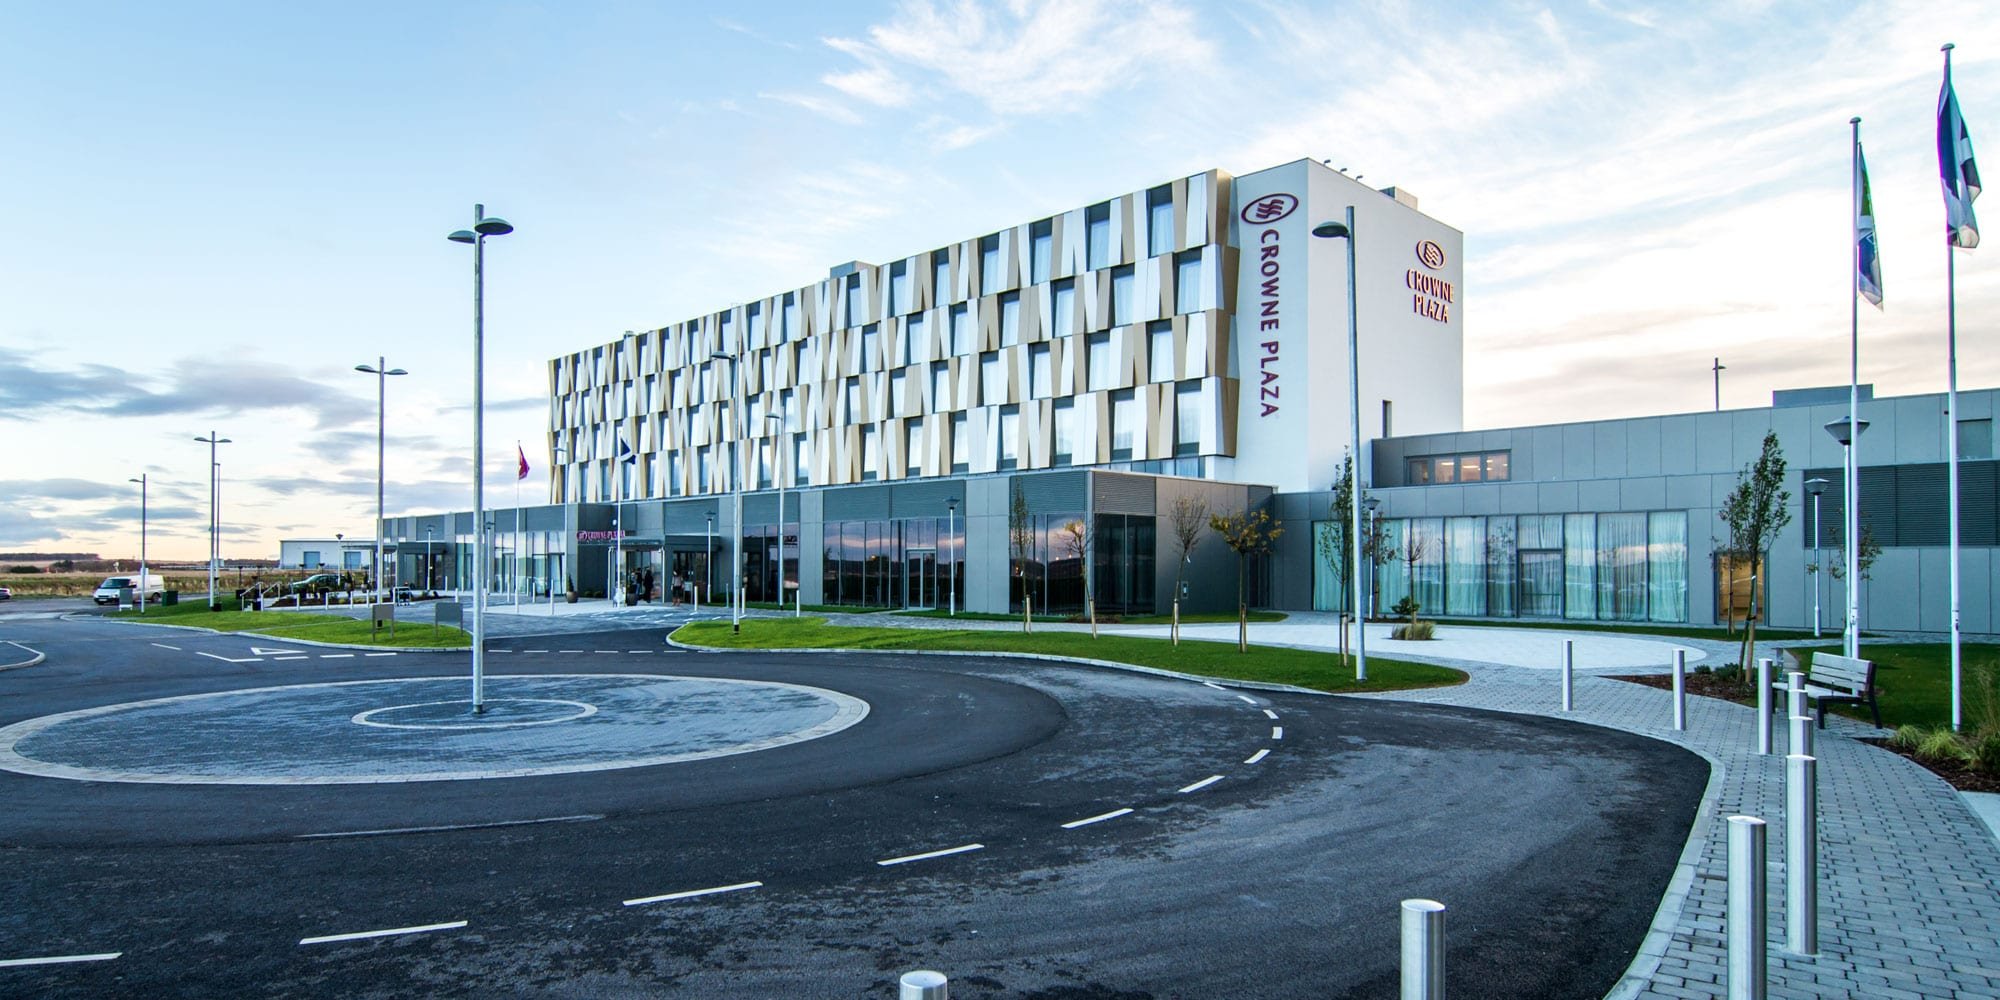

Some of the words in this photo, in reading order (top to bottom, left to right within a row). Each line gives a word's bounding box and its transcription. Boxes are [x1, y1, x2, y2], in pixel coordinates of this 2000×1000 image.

[1260, 229, 1279, 331] CROWNE
[1406, 268, 1454, 303] CROWNE
[1413, 294, 1449, 323] PLAZA
[1260, 341, 1279, 417] PLAZA
